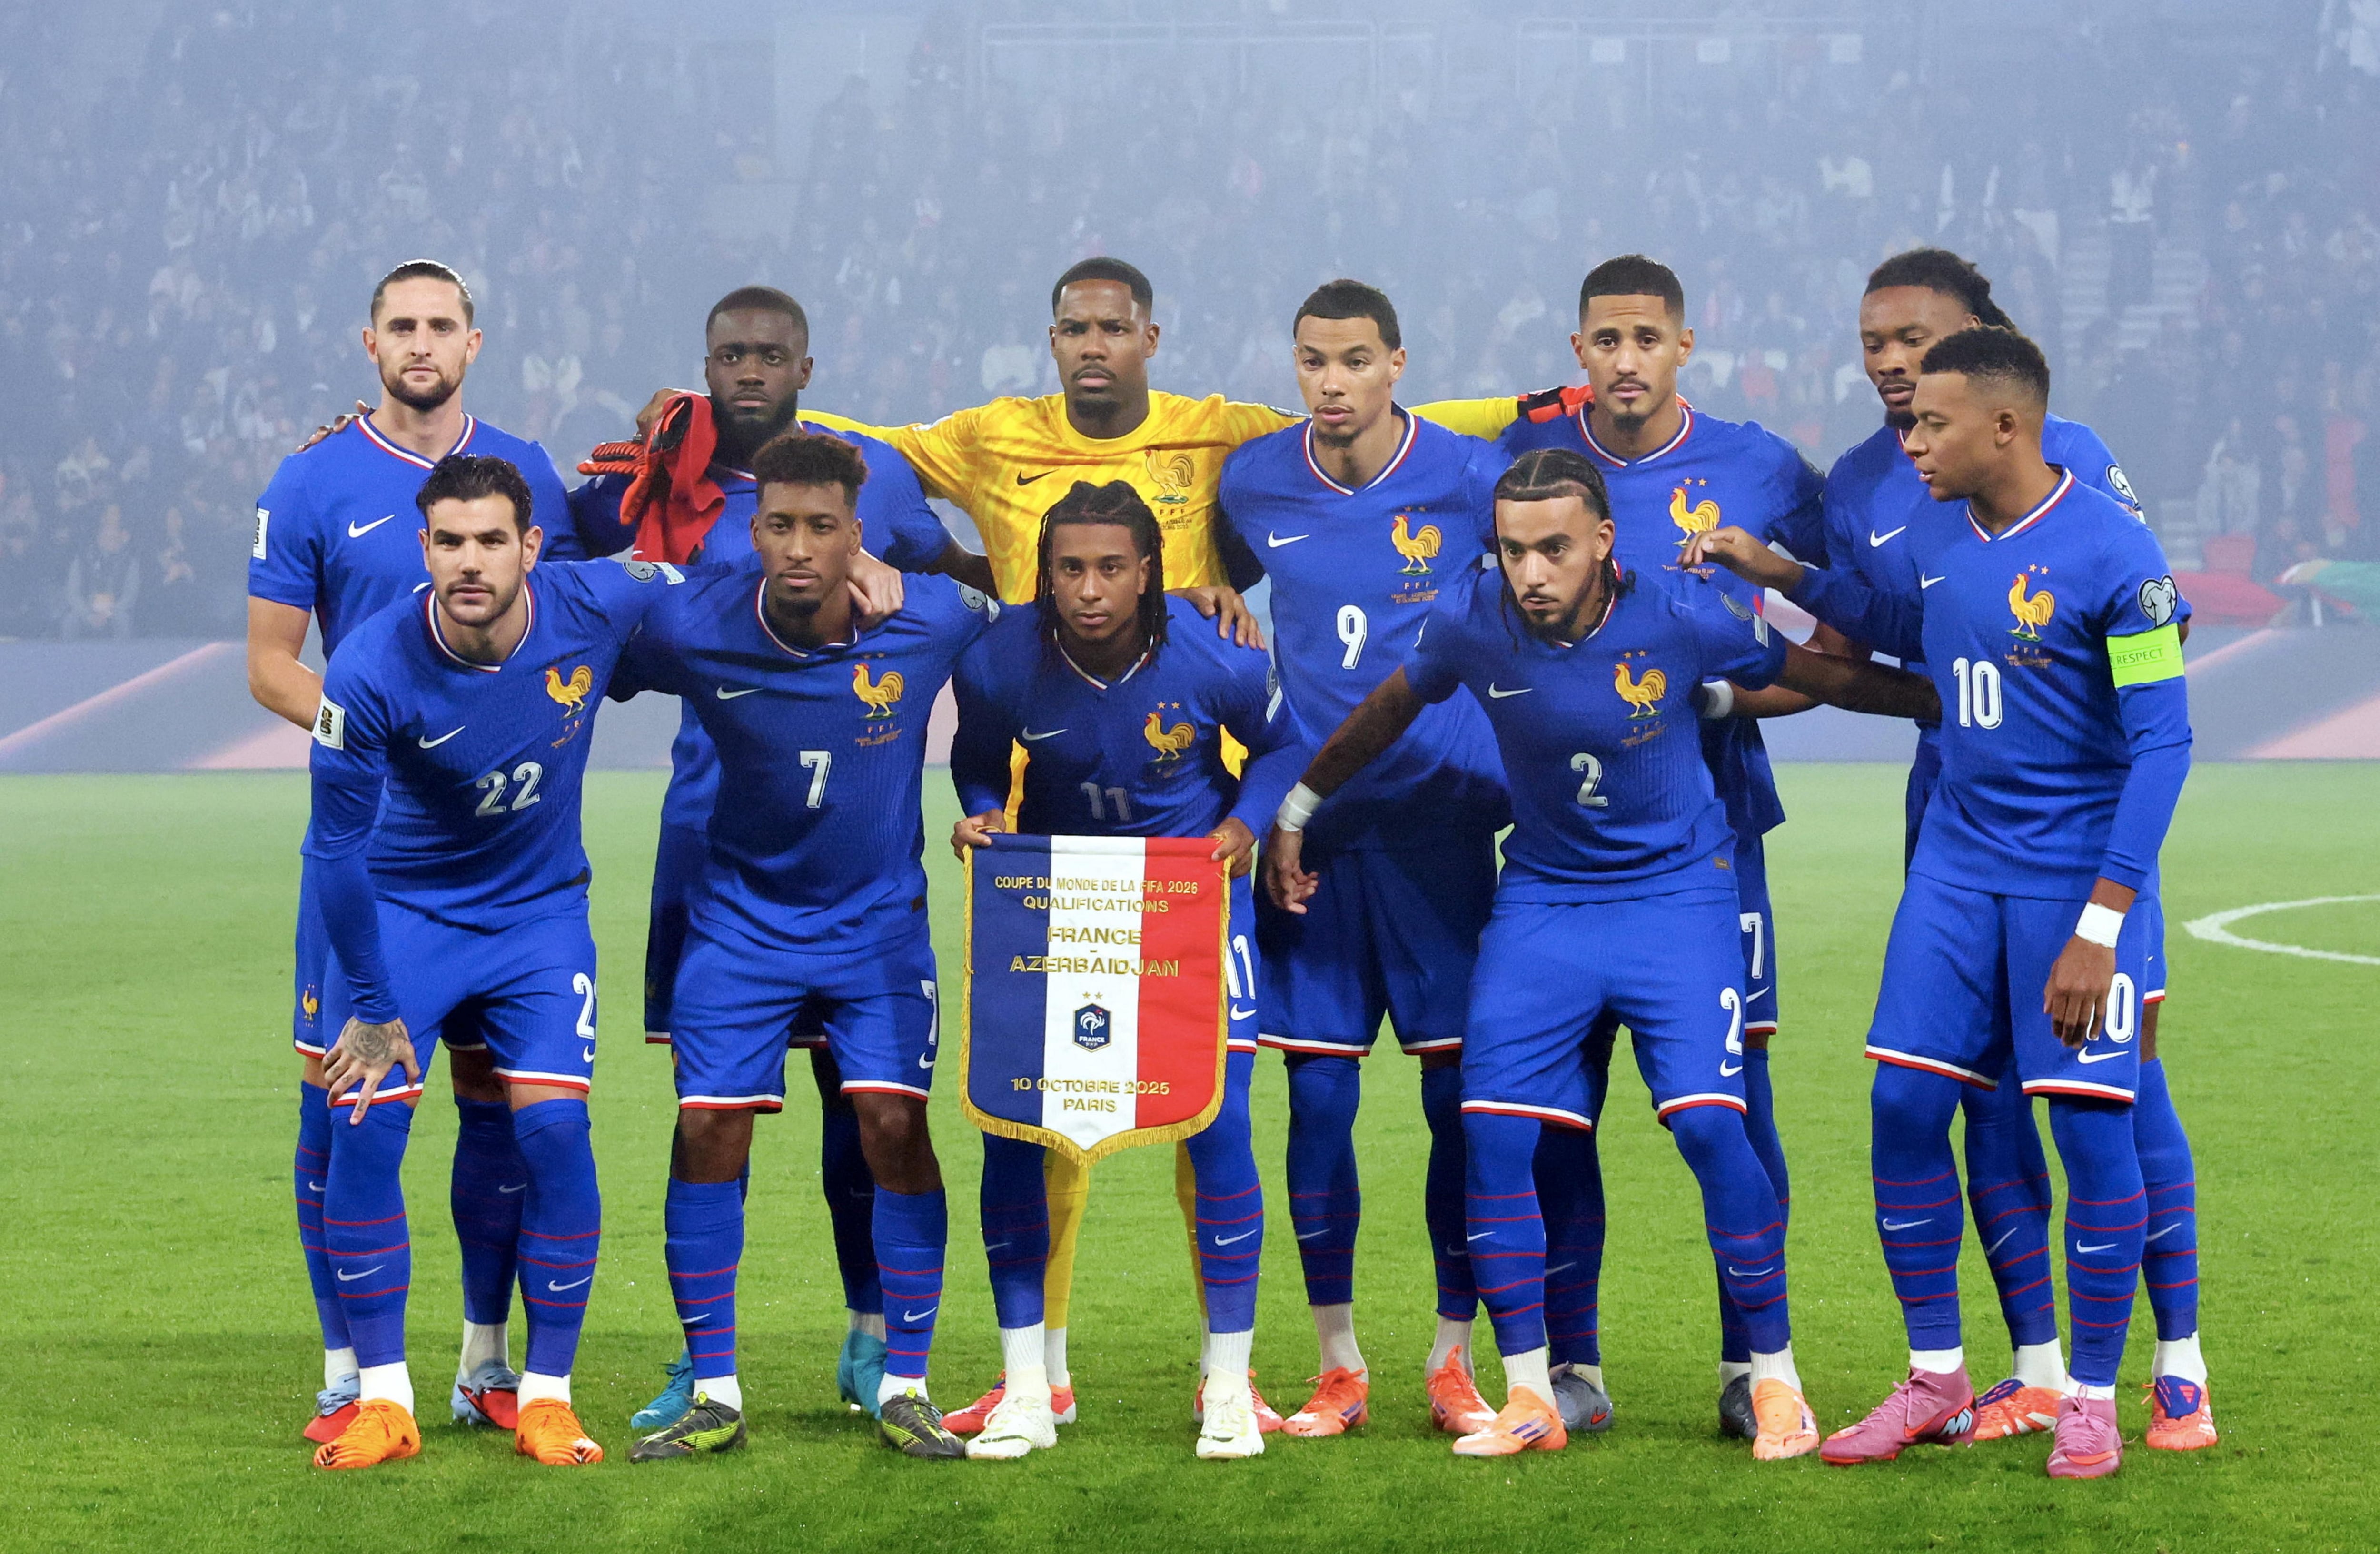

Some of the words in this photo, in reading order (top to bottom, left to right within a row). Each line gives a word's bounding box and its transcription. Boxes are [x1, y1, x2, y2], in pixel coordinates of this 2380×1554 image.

[1337, 604, 1367, 669] 9
[2116, 648, 2163, 665] RESPECT
[1953, 657, 2002, 729] 10
[476, 762, 543, 816] 22
[800, 751, 831, 808] 7
[1081, 782, 1133, 821] 11
[1571, 753, 1608, 807] 2
[995, 876, 1033, 889] COUPE
[1037, 877, 1051, 889] DU
[1056, 877, 1097, 891] MONDE
[1101, 879, 1117, 891] DE
[1121, 879, 1135, 892] LA
[1140, 881, 1163, 893] FIFA
[1168, 881, 1198, 894] 2026
[1023, 896, 1169, 912] QUALIFICATIONS
[1047, 926, 1142, 945] FRANCE
[1010, 955, 1179, 977] AZERBAIDJAN
[572, 972, 597, 1040] 2
[1720, 987, 1742, 1055] 2
[2086, 973, 2134, 1043] 0
[1011, 1078, 1031, 1091] 10
[1037, 1079, 1119, 1093] OCTOBRE
[1124, 1080, 1170, 1095] 2025
[1063, 1098, 1117, 1112] PARIS
